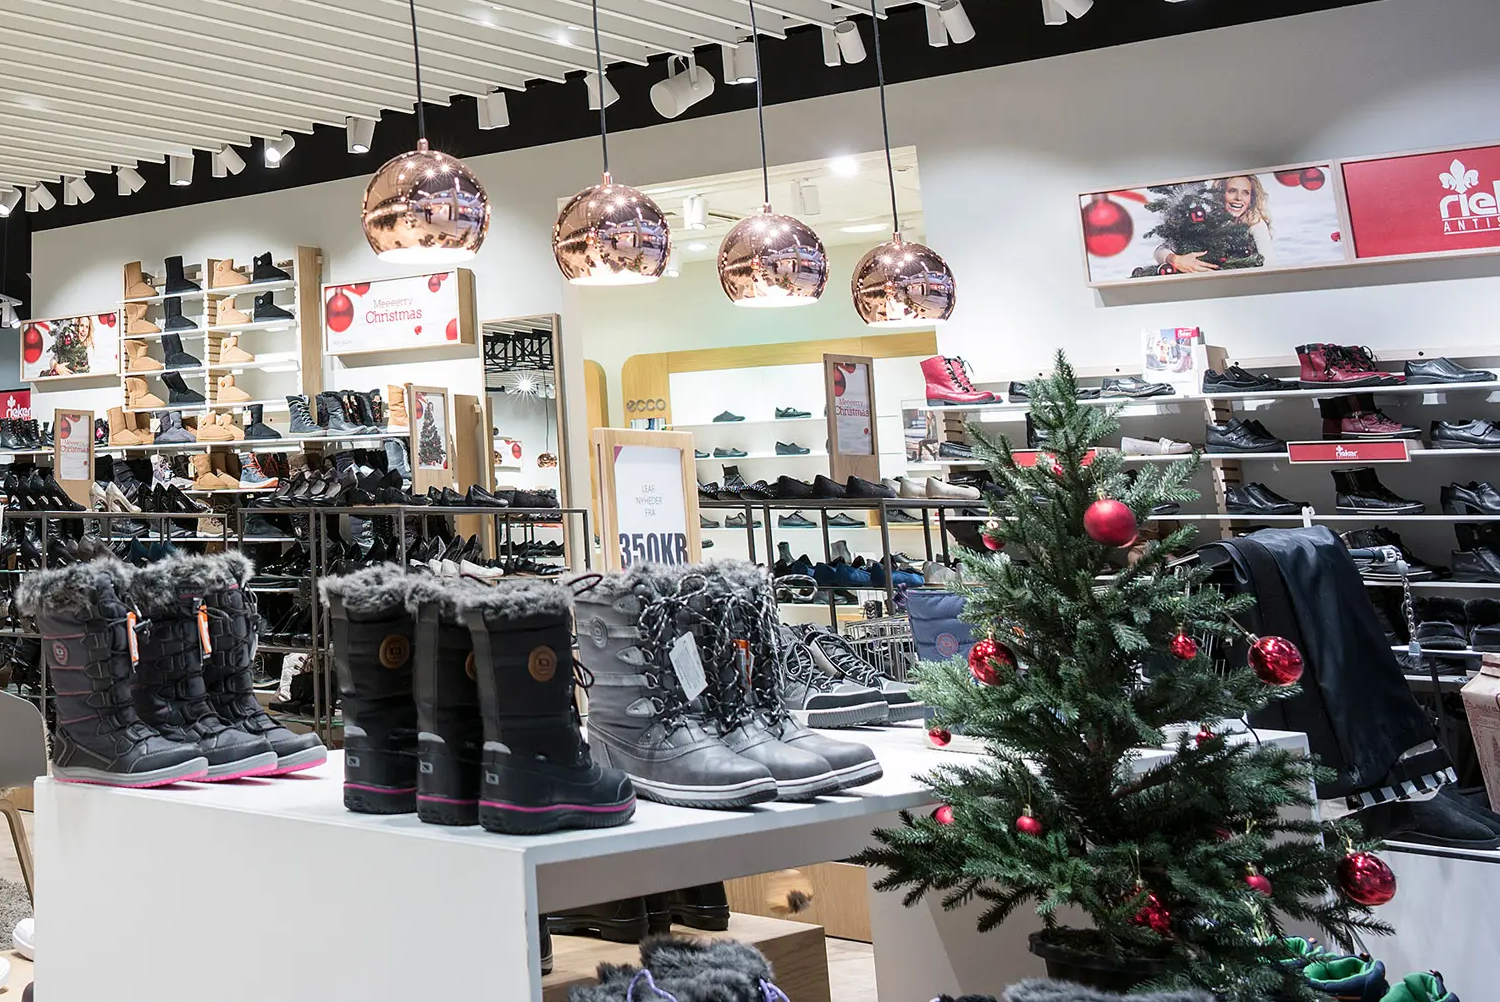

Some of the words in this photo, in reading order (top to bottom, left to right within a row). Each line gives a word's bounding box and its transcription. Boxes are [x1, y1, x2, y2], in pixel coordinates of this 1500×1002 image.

[1440, 180, 1500, 218] rie
[365, 308, 423, 324] Christmas
[626, 398, 666, 412] ecco
[835, 405, 870, 417] Christmas
[619, 532, 688, 569] 350KR
